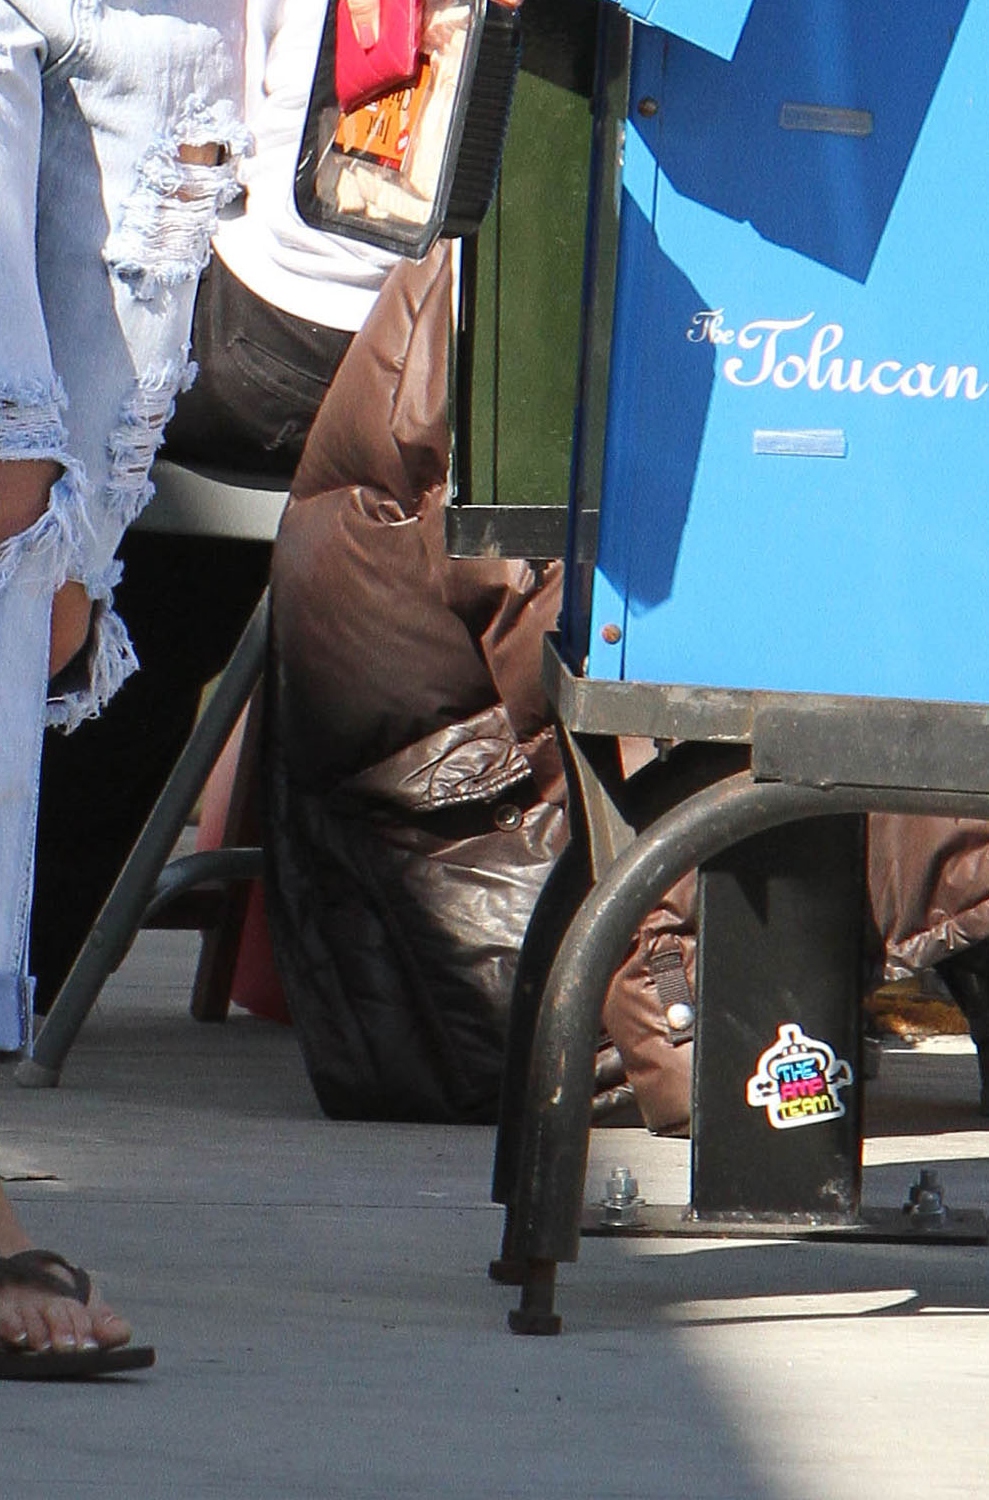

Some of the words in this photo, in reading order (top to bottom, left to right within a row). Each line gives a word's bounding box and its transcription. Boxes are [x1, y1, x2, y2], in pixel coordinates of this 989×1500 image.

[686, 307, 735, 345] The
[724, 312, 989, 400] Tolucan
[777, 1058, 819, 1083] THE
[778, 1095, 833, 1119] TEAM
